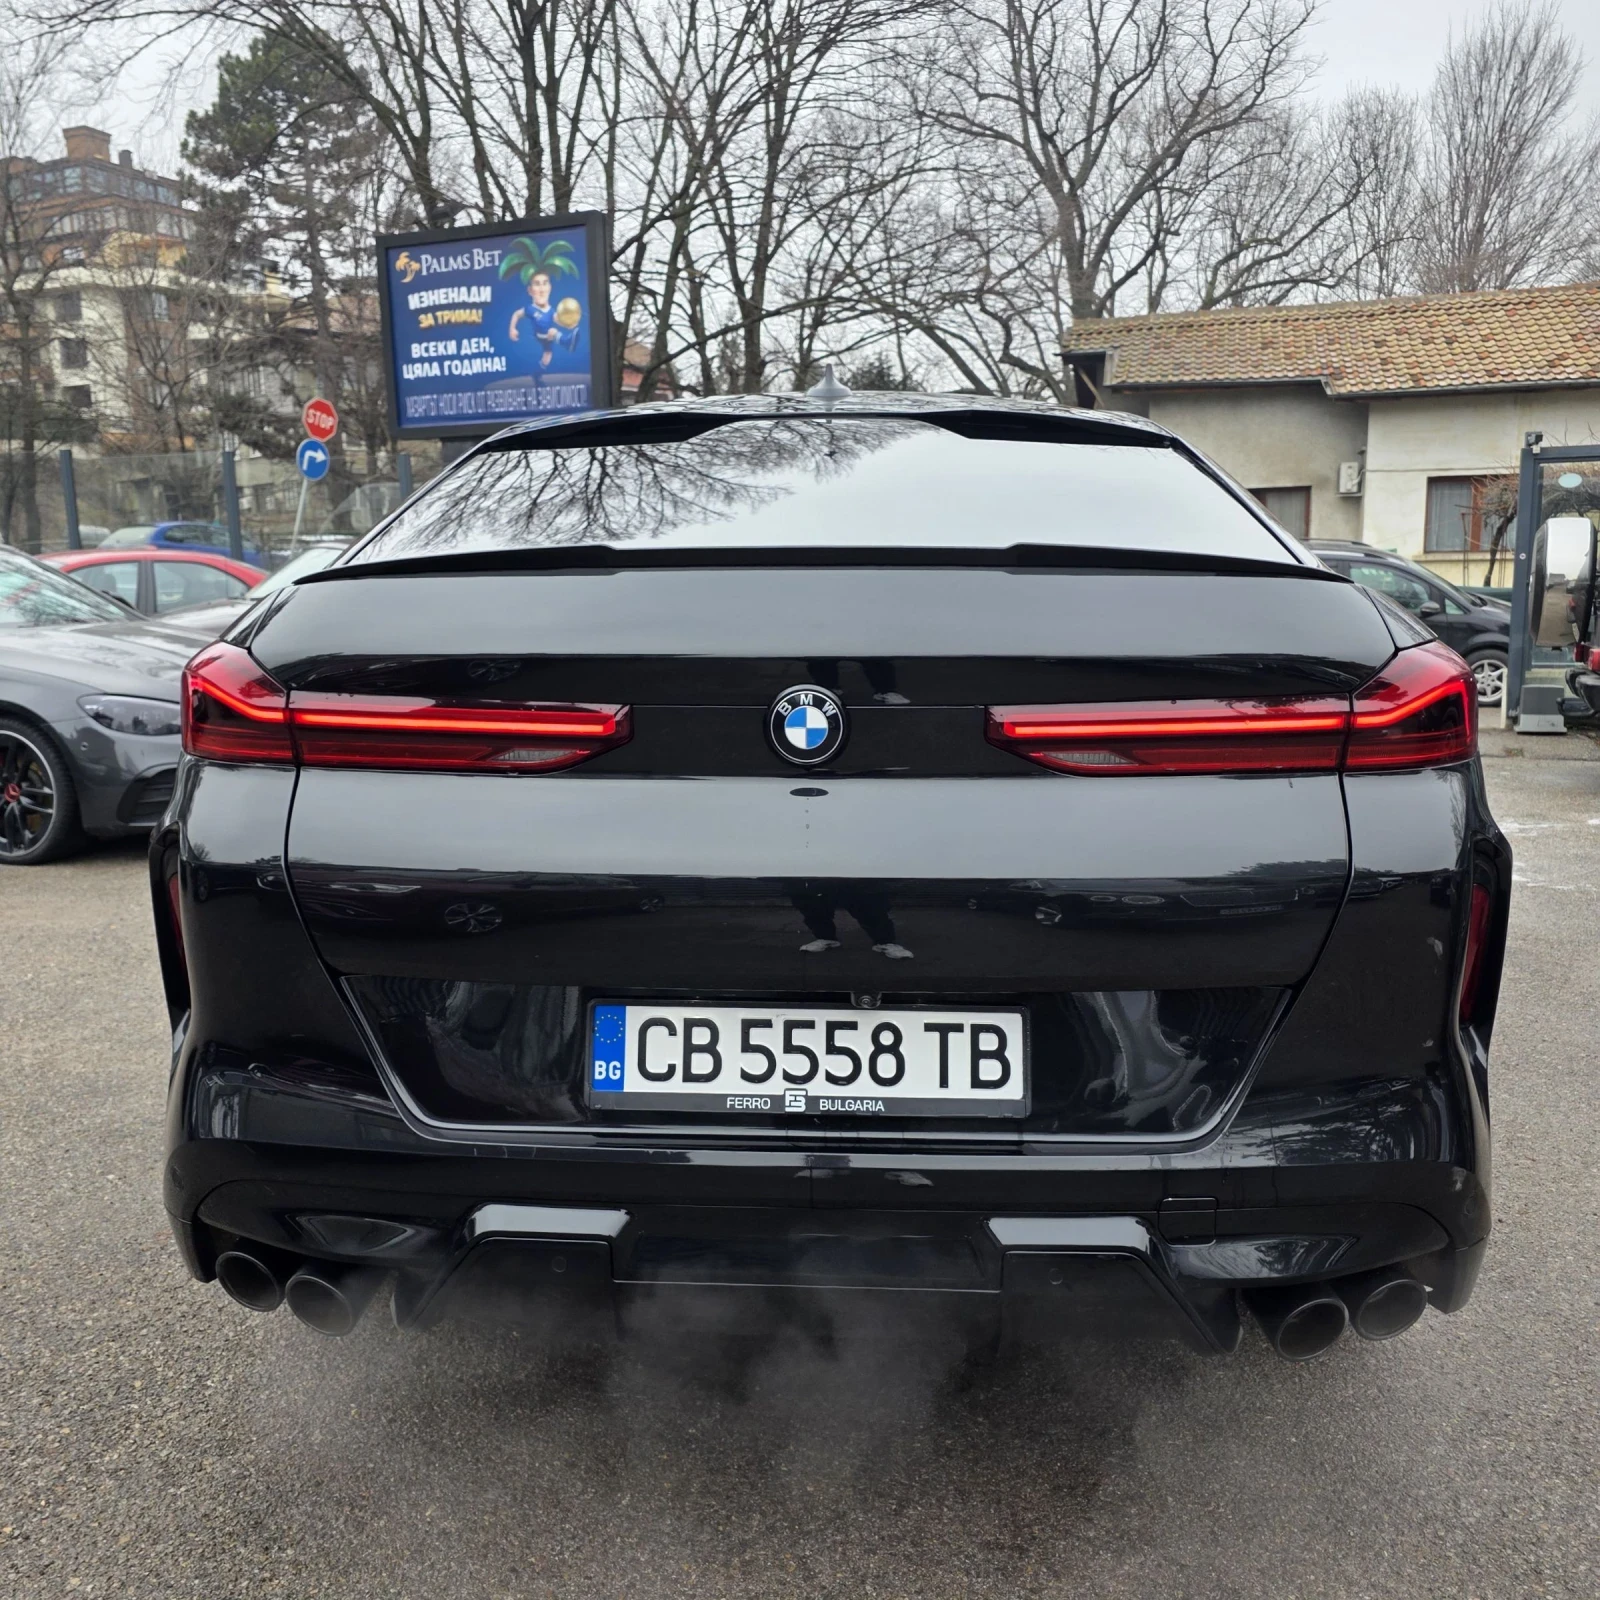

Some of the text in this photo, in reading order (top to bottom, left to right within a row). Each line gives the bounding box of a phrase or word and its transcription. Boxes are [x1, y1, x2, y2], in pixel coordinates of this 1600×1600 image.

[420, 248, 502, 276] PALMS BET
[408, 286, 492, 310] ИЗНЕНАДИ
[418, 309, 482, 328] ЗА ТРИМА!
[411, 337, 495, 359] ВСЕКИ ДЕН,
[402, 356, 507, 380] ЦЯЛА ГОДИНА!
[307, 408, 334, 430] STOP
[778, 693, 837, 717] BMW
[594, 1017, 1012, 1089] BG CB 5558 TB
[726, 1096, 771, 1109] FERRO
[819, 1099, 885, 1112] BULGARIA
